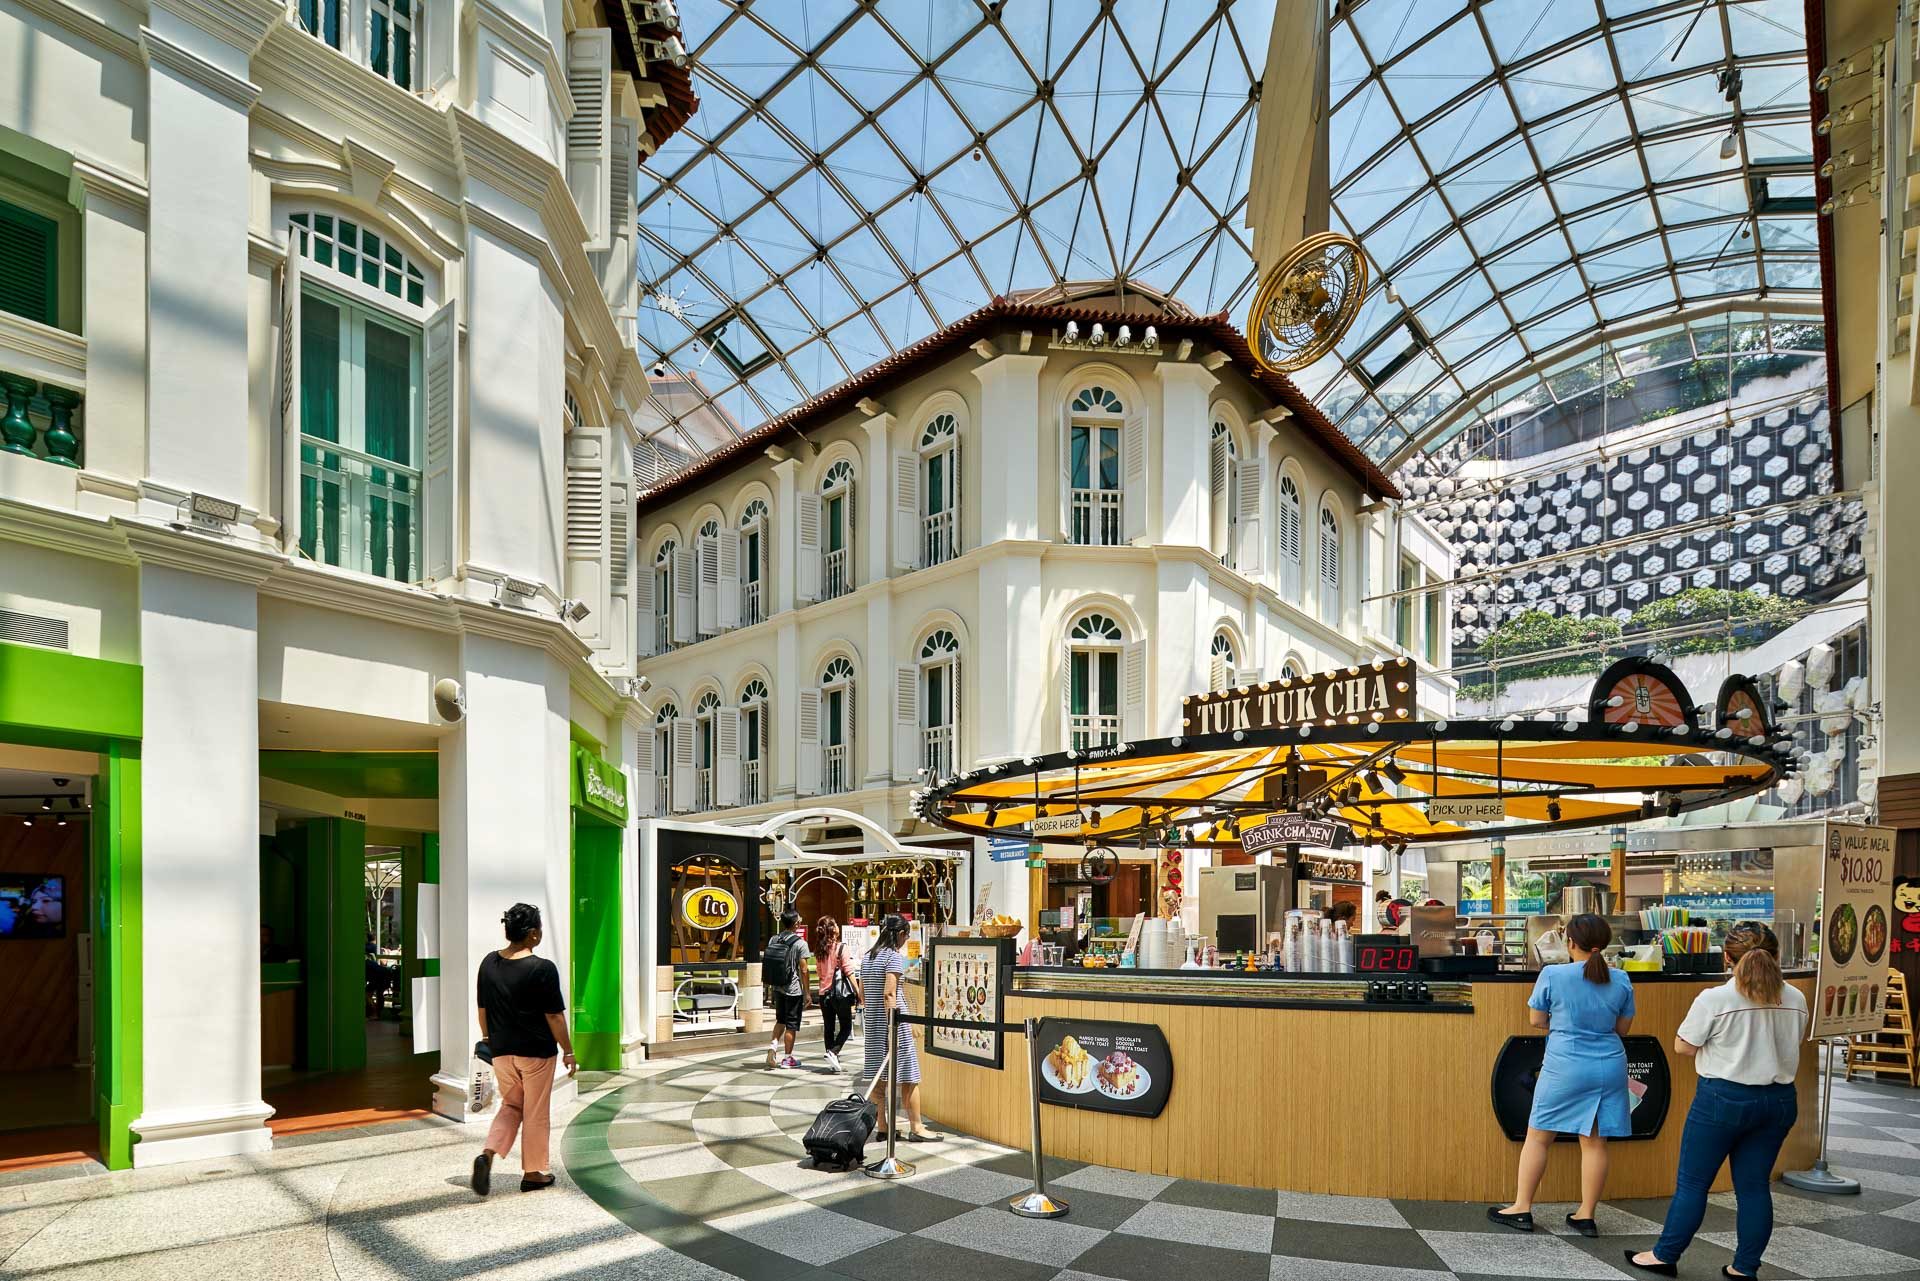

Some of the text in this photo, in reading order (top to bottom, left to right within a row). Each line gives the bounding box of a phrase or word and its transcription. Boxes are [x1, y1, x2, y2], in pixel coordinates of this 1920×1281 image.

[1197, 674, 1391, 735] TUK TUK CHA
[1432, 803, 1503, 816] PICK UP HERE
[1034, 818, 1080, 831] ORDER HERE
[1246, 825, 1331, 846] DRINK CHA YEN
[1627, 837, 1656, 846] REET
[1844, 836, 1890, 852] VALUE MEAL
[1840, 853, 1883, 887] $10.80
[704, 896, 728, 916] tcc
[1467, 901, 1489, 910] More
[1361, 948, 1413, 970] 020
